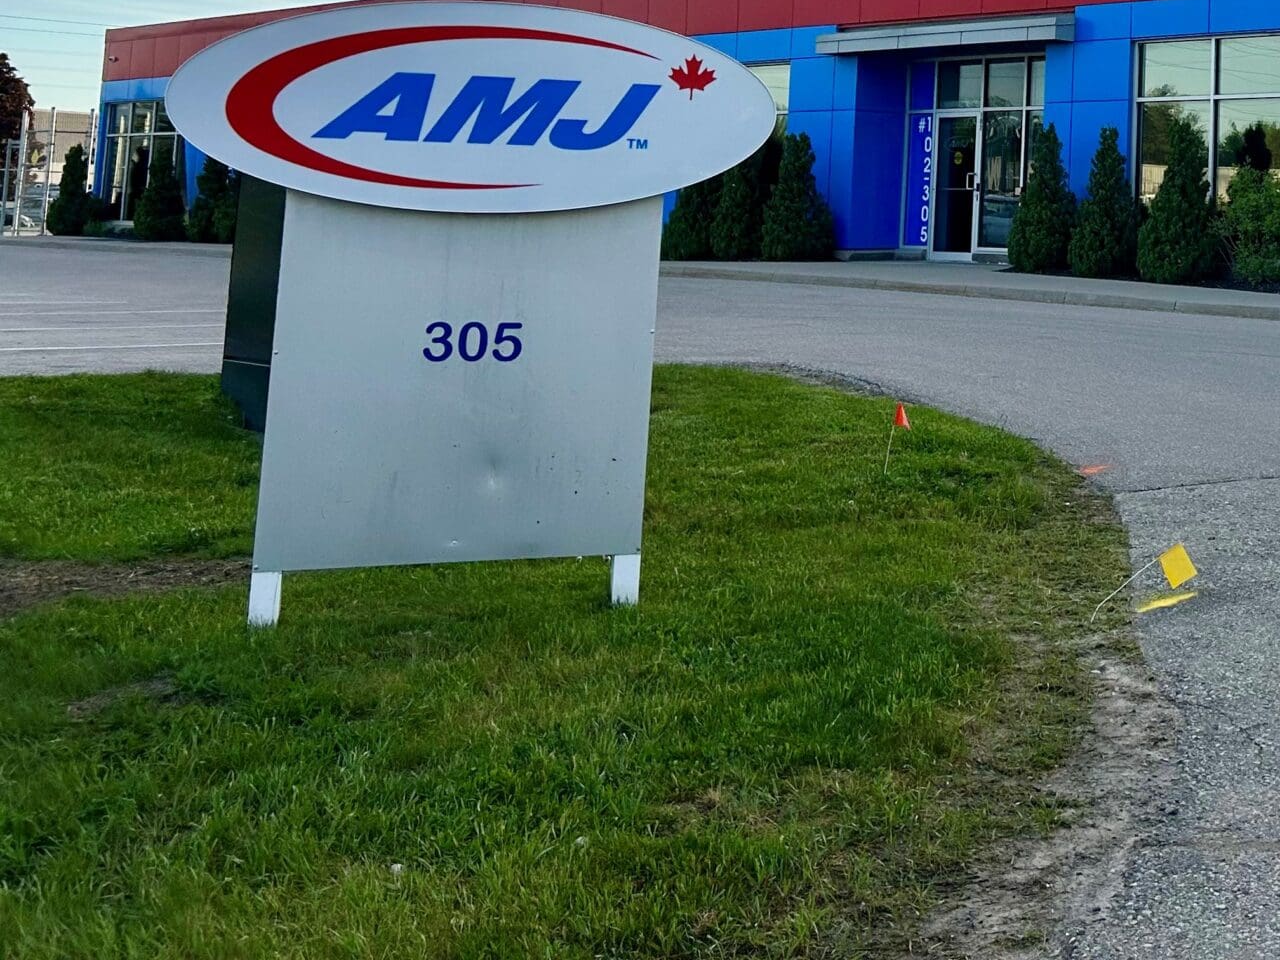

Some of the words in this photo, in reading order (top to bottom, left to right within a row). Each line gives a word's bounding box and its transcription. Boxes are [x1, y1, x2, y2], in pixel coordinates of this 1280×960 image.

[311, 72, 662, 150] AMJ
[627, 138, 648, 149] TM
[423, 320, 524, 364] 305
